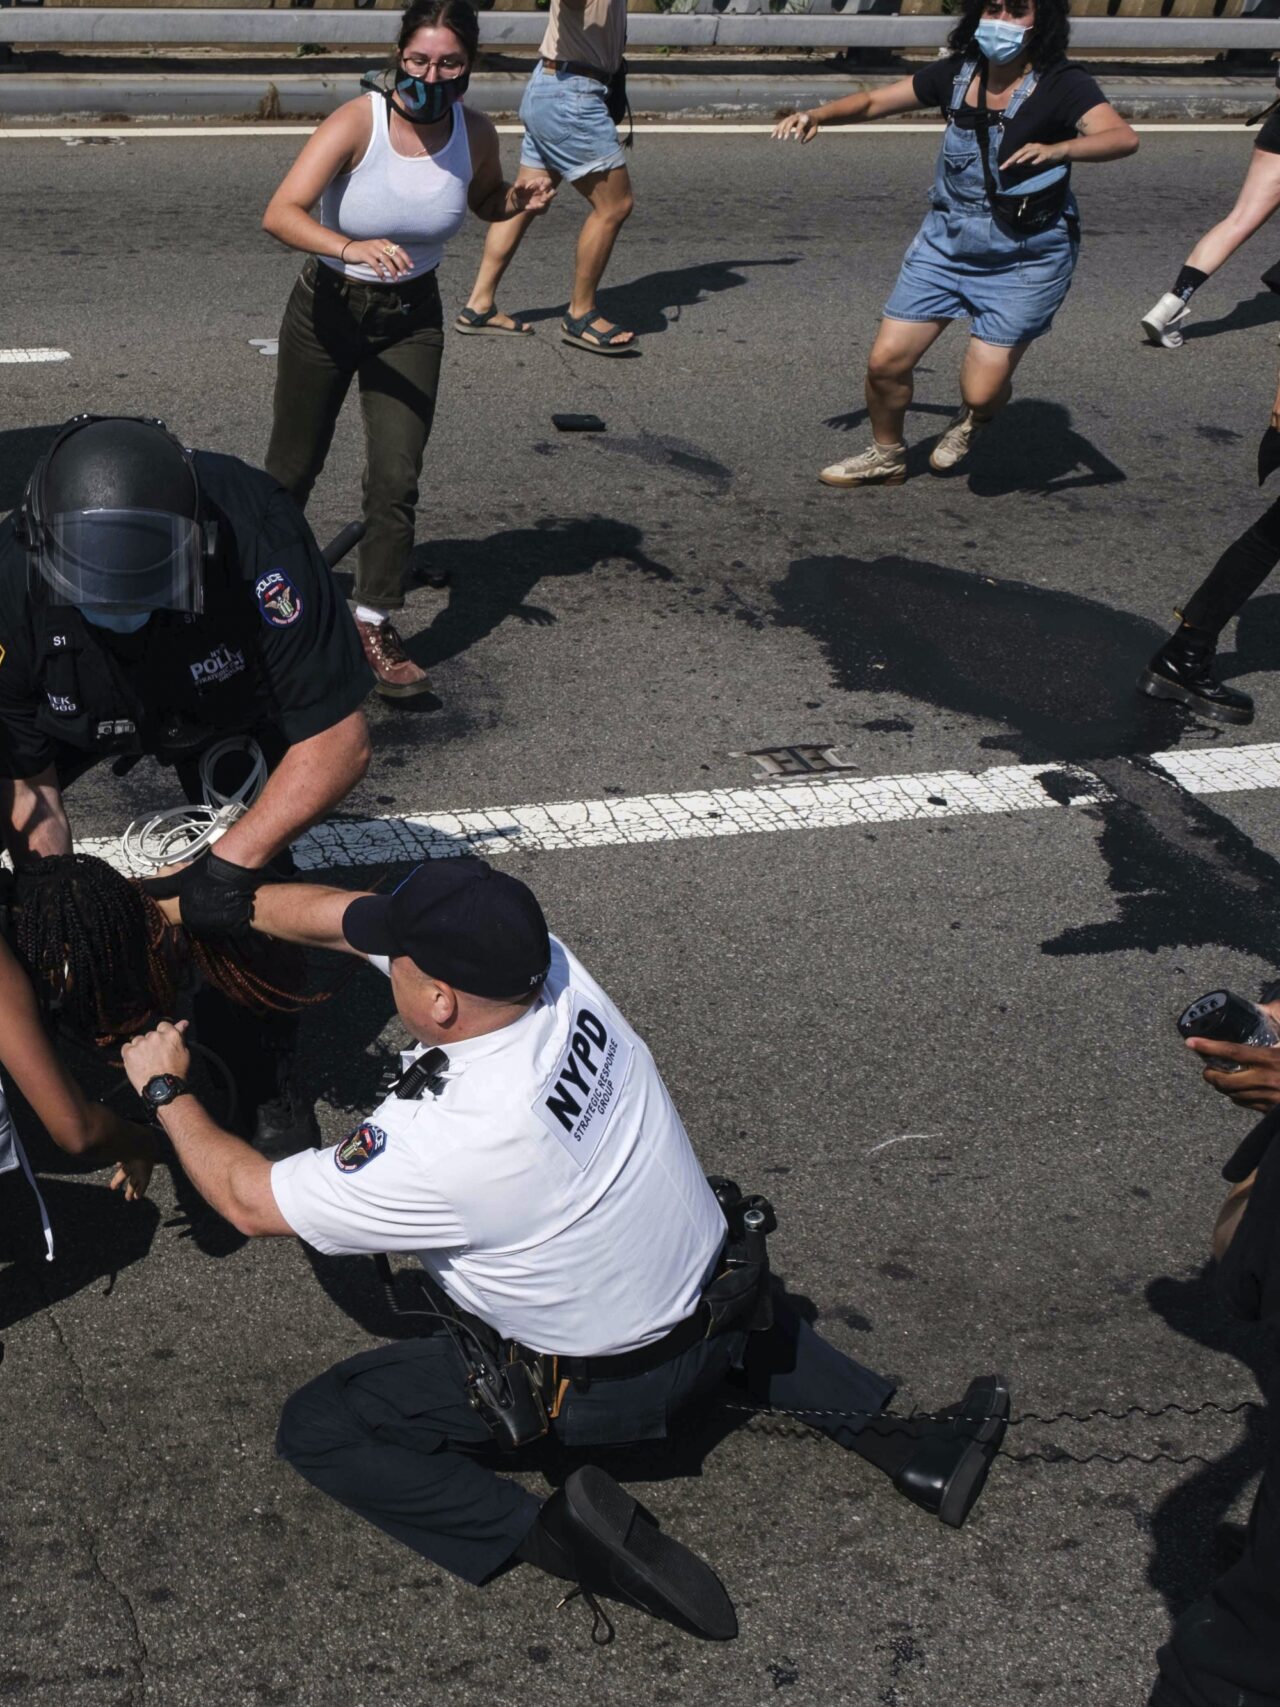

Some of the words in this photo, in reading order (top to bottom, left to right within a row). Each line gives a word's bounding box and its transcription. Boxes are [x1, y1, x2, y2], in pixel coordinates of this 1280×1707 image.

[255, 572, 285, 599] POLICE
[53, 635, 67, 647] S1
[545, 1008, 608, 1134] NYPD
[573, 1087, 603, 1143] STRATEGIC
[596, 1037, 619, 1089] RESPONSE
[596, 1083, 616, 1116] GROUP
